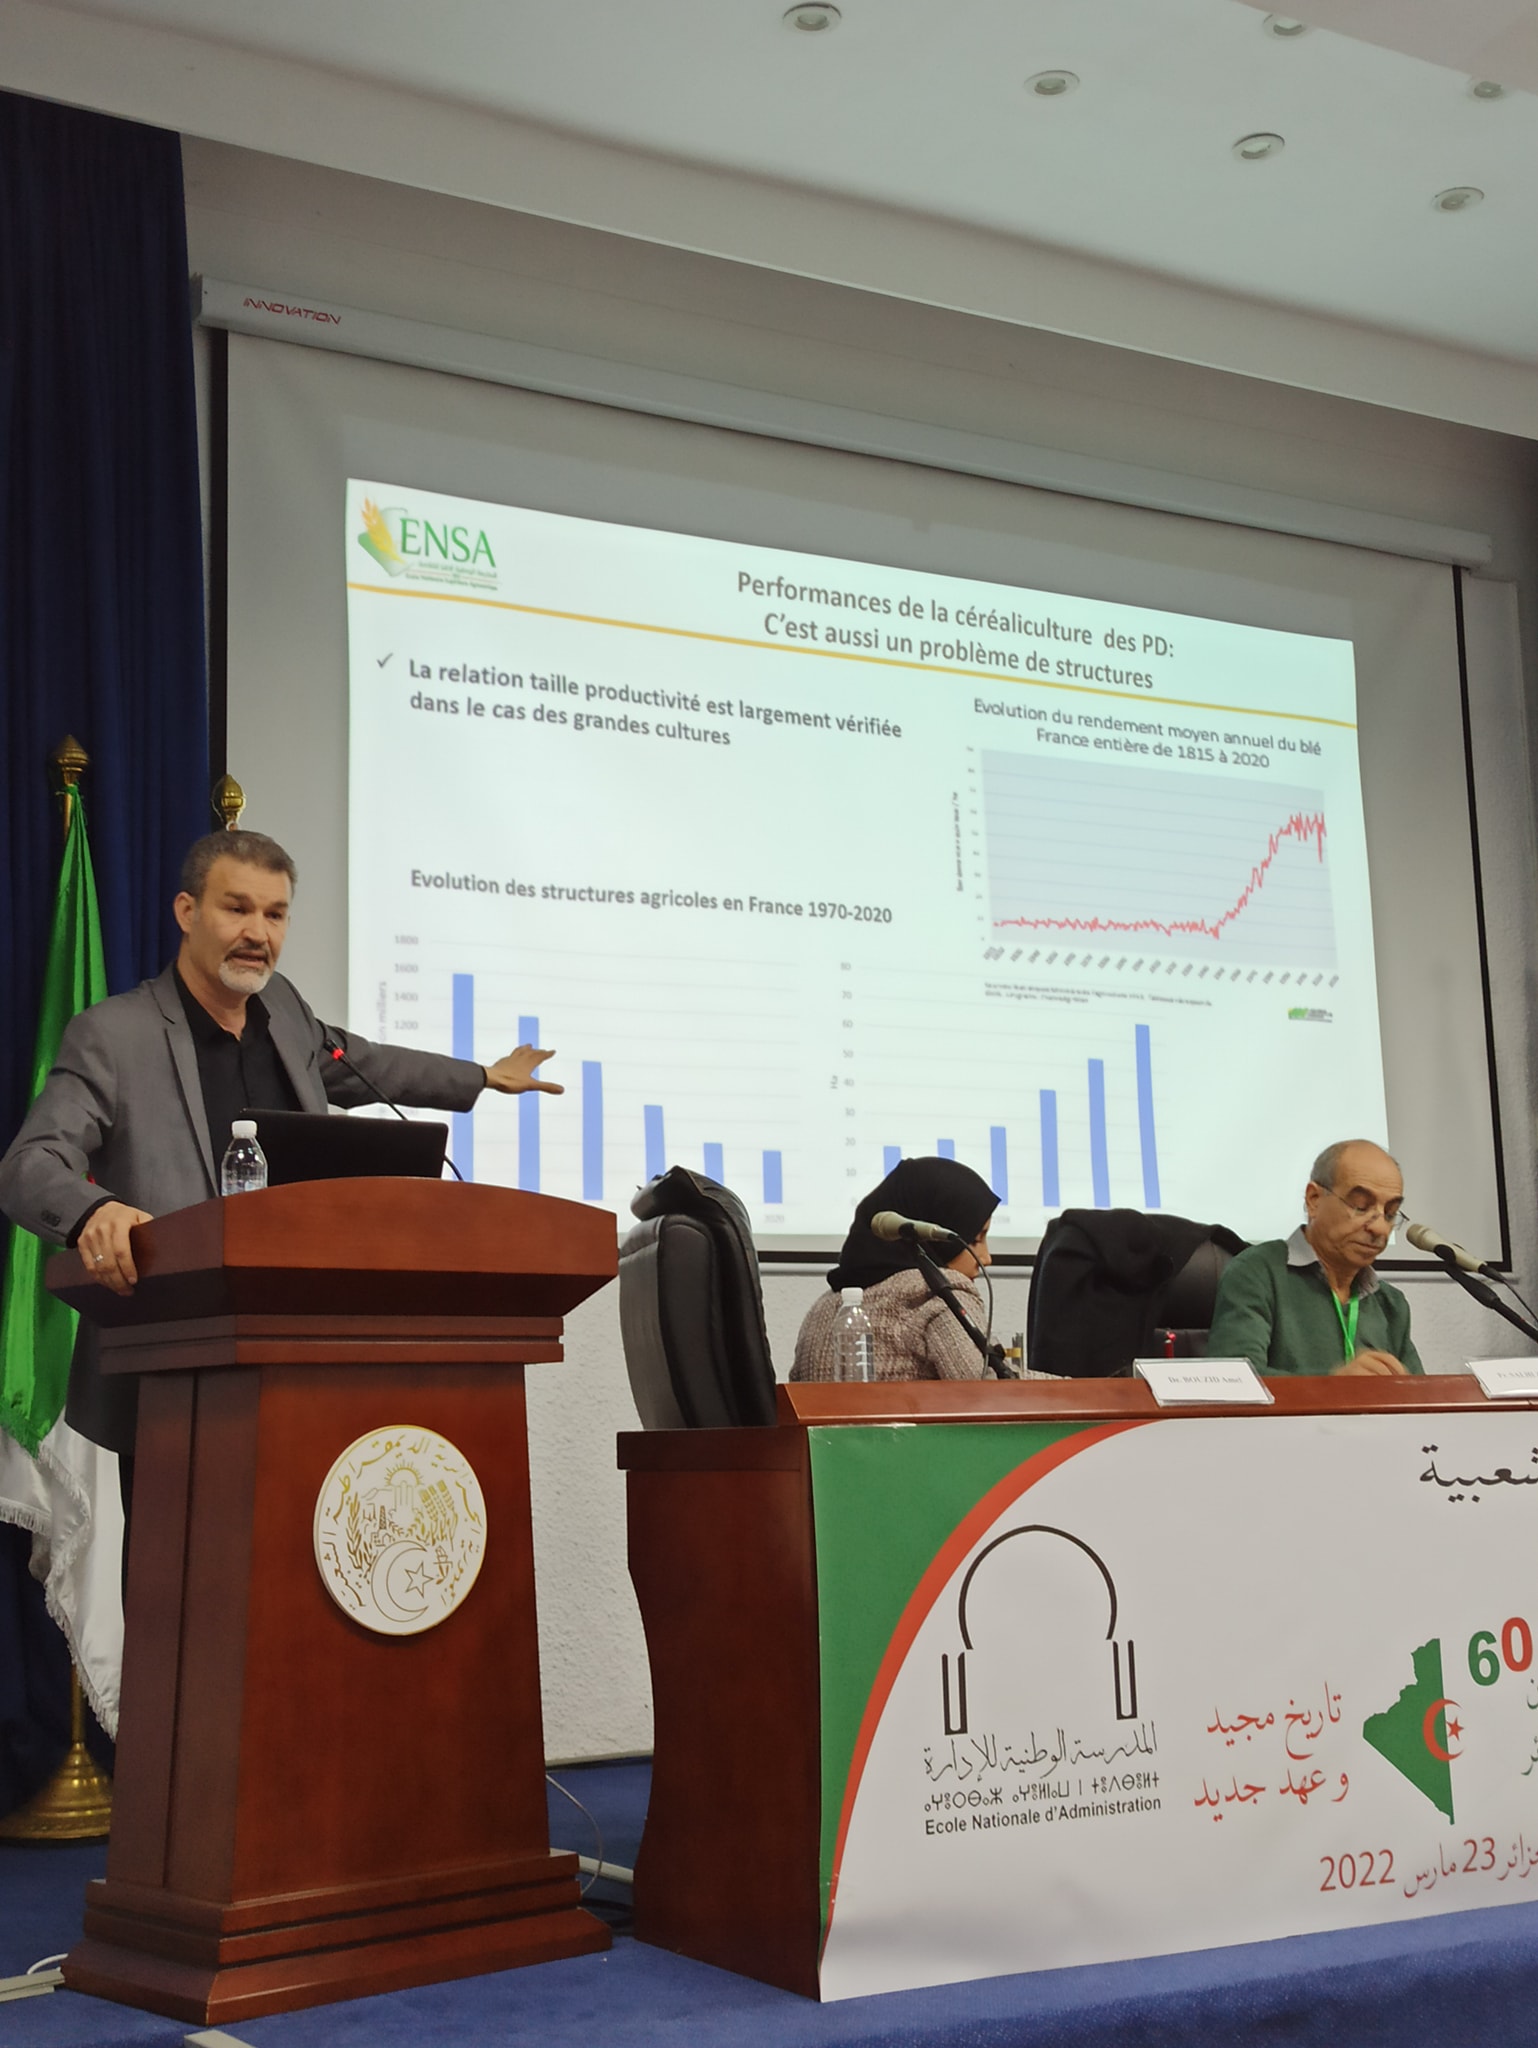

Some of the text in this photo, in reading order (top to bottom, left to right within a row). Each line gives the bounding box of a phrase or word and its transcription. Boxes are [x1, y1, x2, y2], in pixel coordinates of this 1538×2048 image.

[243, 298, 341, 324] INNOVATION
[400, 517, 496, 568] ENSA
[738, 571, 1174, 657] Performances de la céréaliculture des PD:
[764, 613, 1153, 688] C’est aussi un problème de structures
[409, 659, 902, 738] La relation taille productivité est largement vérifiée
[410, 691, 731, 745] dans le cas des grandes cultures
[974, 698, 1321, 756] Evolution du rendement moyen annuel du blé
[1037, 728, 1270, 768] France entière de 1815 à 2020
[411, 869, 892, 923] Evolution des structures agricoles en France 1970-2020
[394, 963, 419, 973] 1600
[394, 992, 419, 1001] 1400
[394, 1020, 419, 1030] 1200
[1468, 1617, 1533, 1686] 60
[1070, 1720, 1158, 1765] المدرسة
[1207, 1680, 1342, 1760] تاريخ مجيد
[1000, 1728, 1067, 1779] الوطنية
[925, 1796, 1161, 1835] Ecole Nationale d'Administration
[1194, 1768, 1349, 1822] و عهد جديد
[1320, 1832, 1538, 1898] زائر 23 مارس 2022
